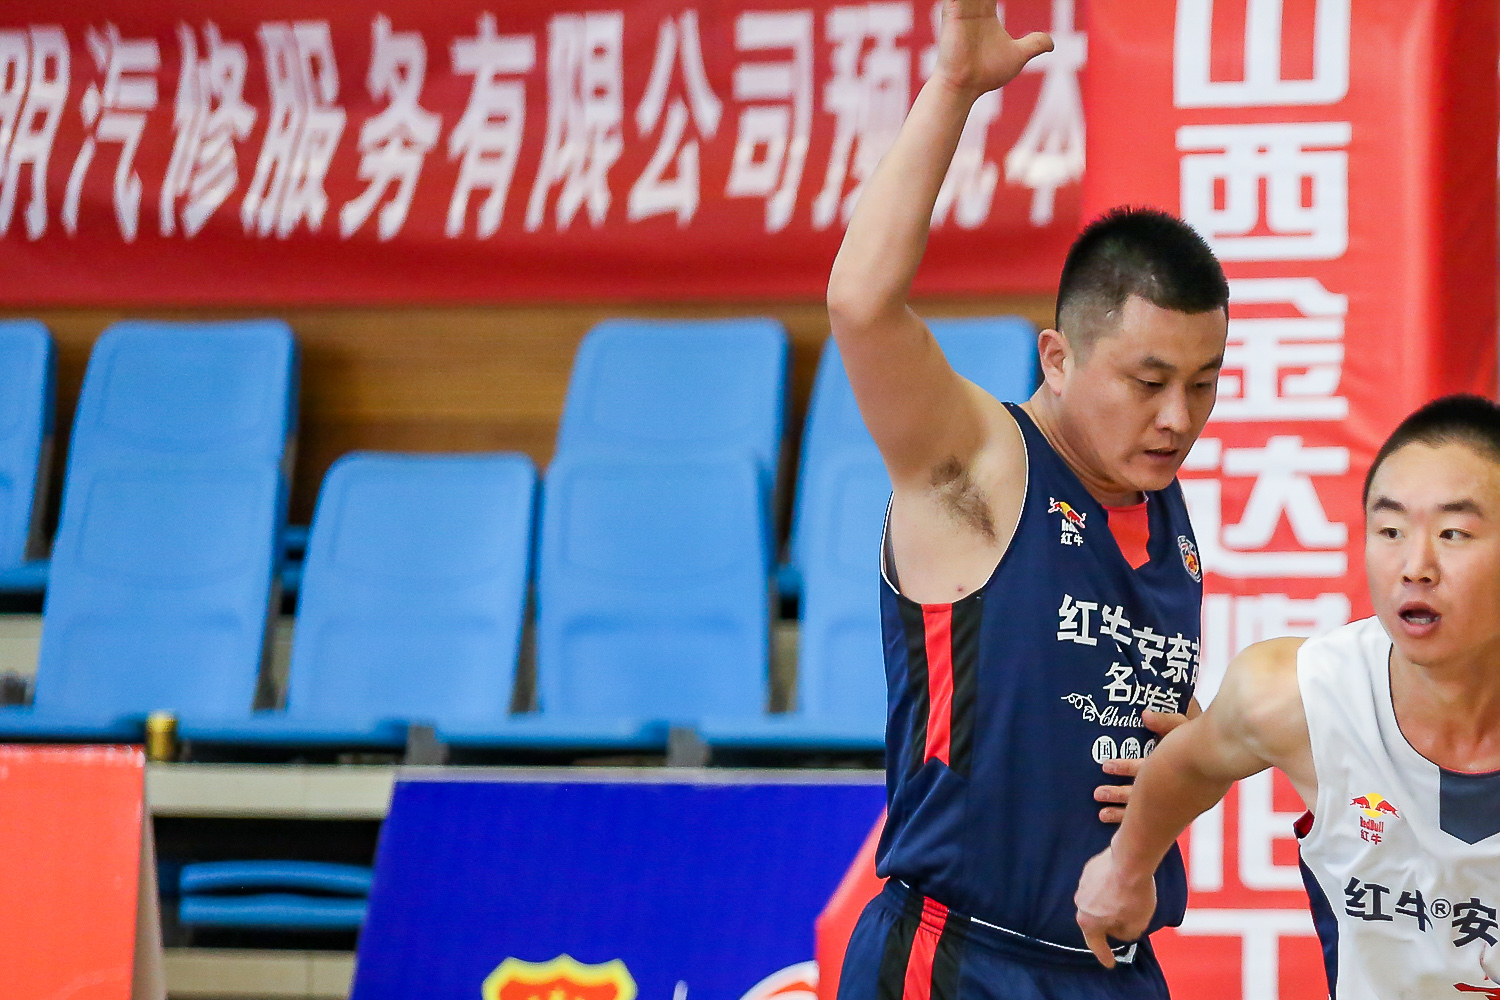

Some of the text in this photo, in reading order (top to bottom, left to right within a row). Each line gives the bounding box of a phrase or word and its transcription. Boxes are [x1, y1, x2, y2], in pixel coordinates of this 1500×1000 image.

[0, 0, 1087, 243] 明汽修服务有限公司预本
[1360, 828, 1383, 846] 红牛
